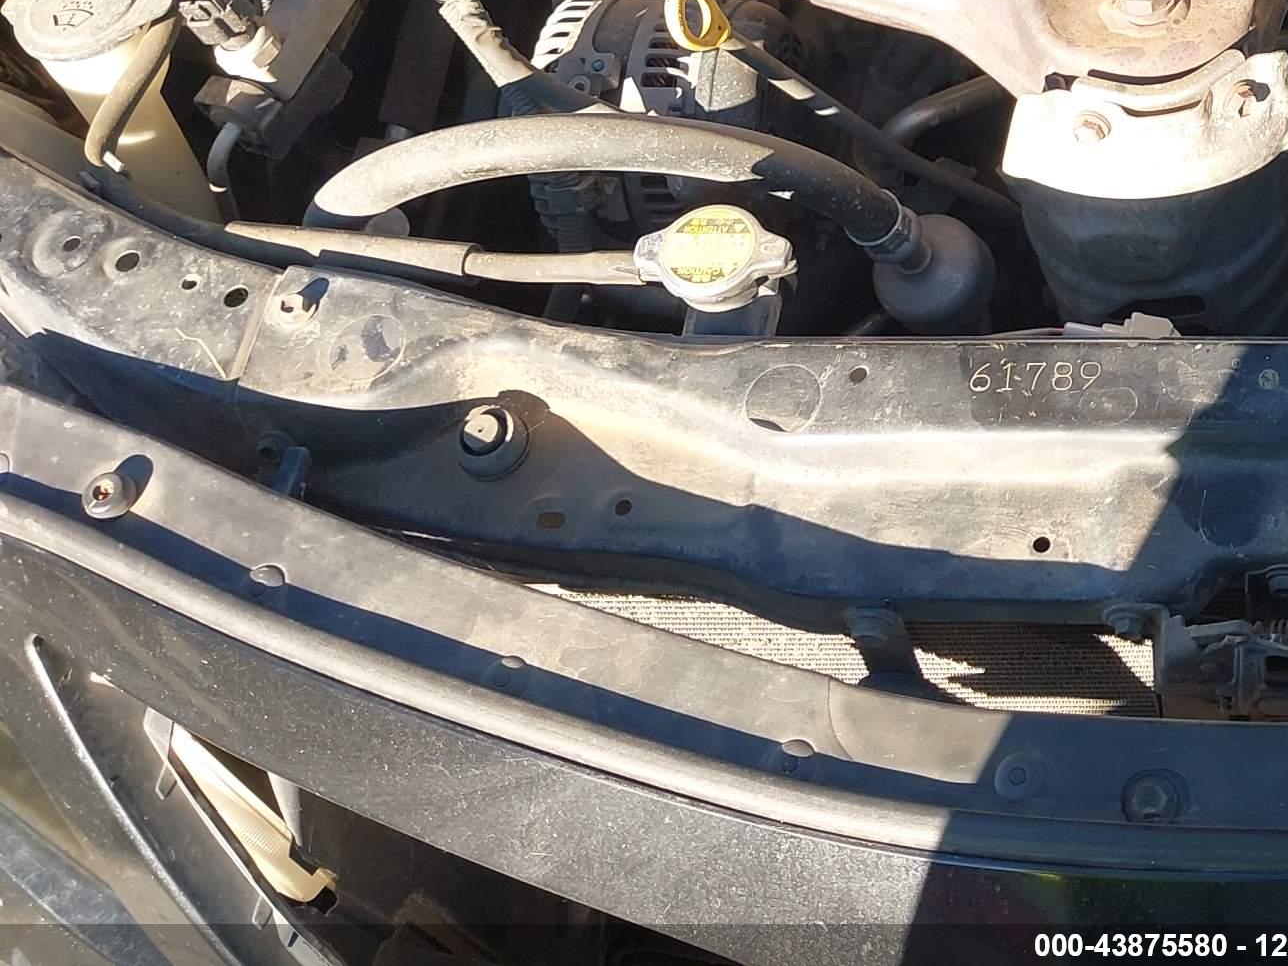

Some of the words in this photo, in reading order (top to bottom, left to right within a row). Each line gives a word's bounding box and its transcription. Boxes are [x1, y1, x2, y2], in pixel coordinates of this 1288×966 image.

[684, 225, 729, 234] ATTENTION
[677, 267, 721, 276] CAUTION
[969, 361, 1102, 393] 61789
